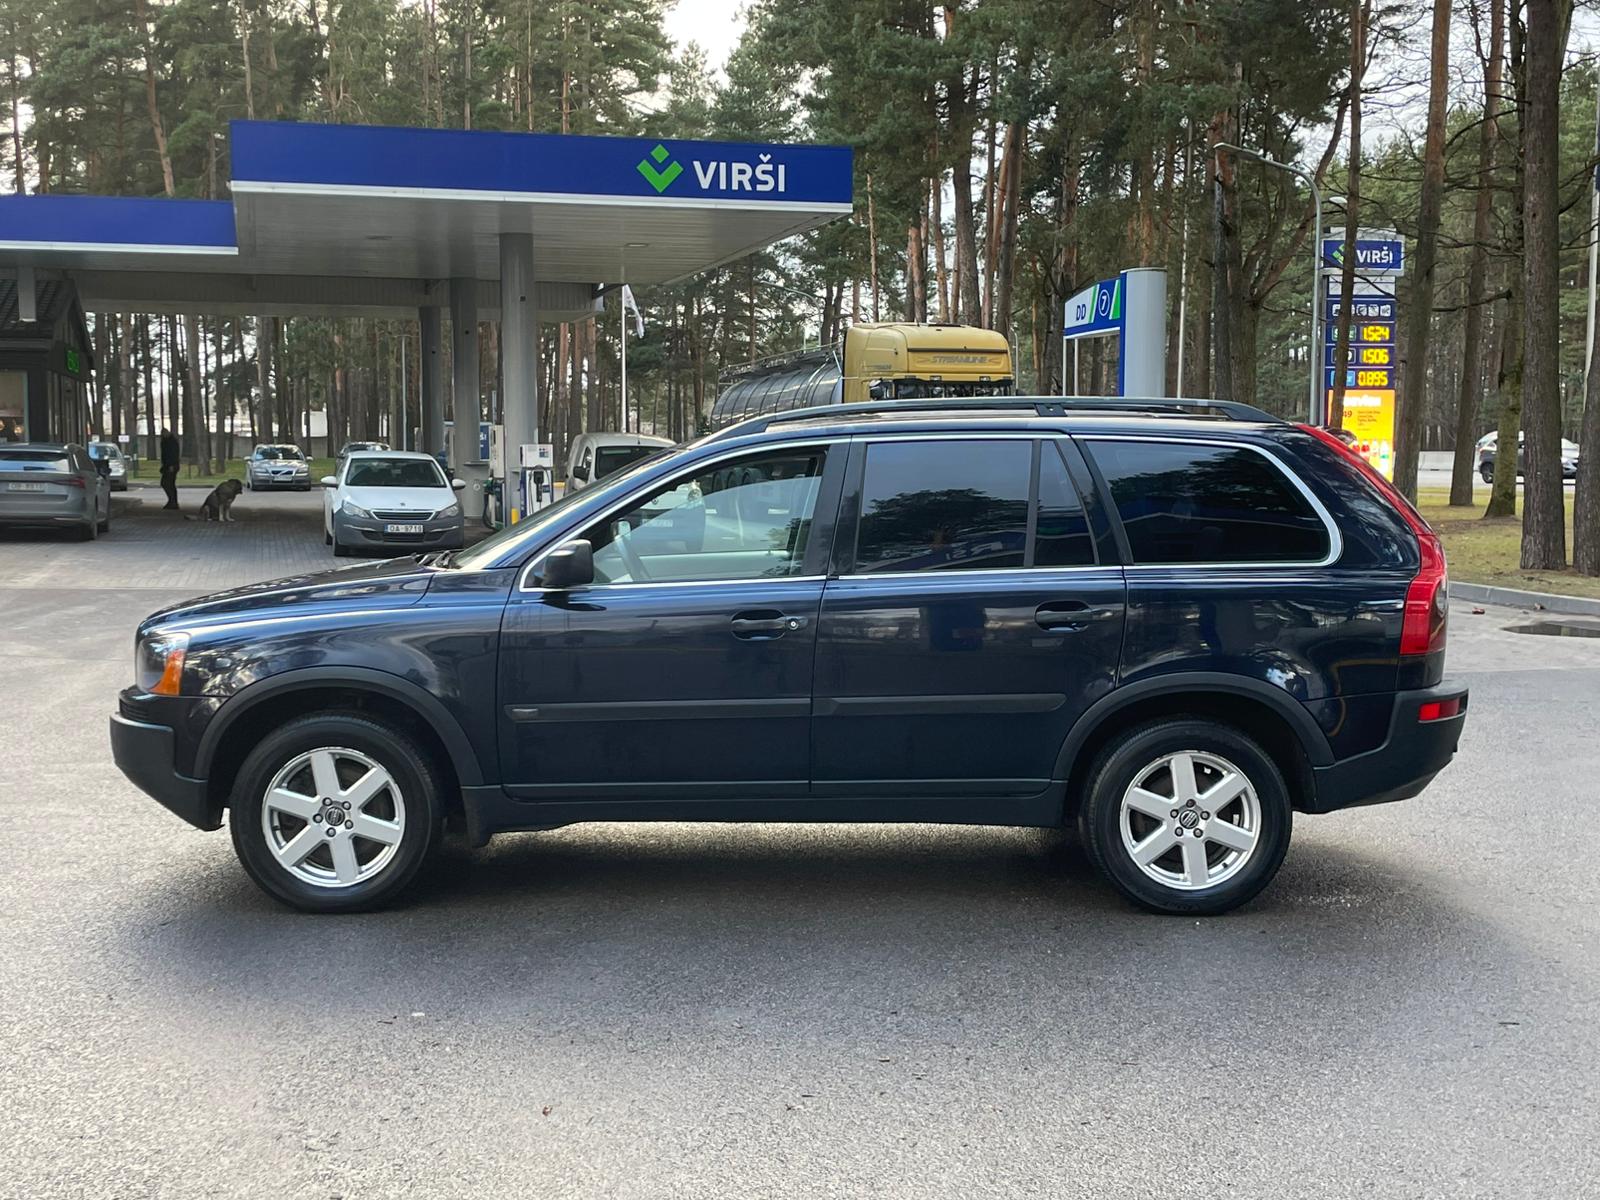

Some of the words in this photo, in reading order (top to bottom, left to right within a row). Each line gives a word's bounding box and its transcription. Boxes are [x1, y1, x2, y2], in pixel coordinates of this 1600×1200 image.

[692, 152, 786, 193] VIRŠI
[1356, 245, 1394, 264] VIRŠI
[1075, 303, 1087, 321] DD
